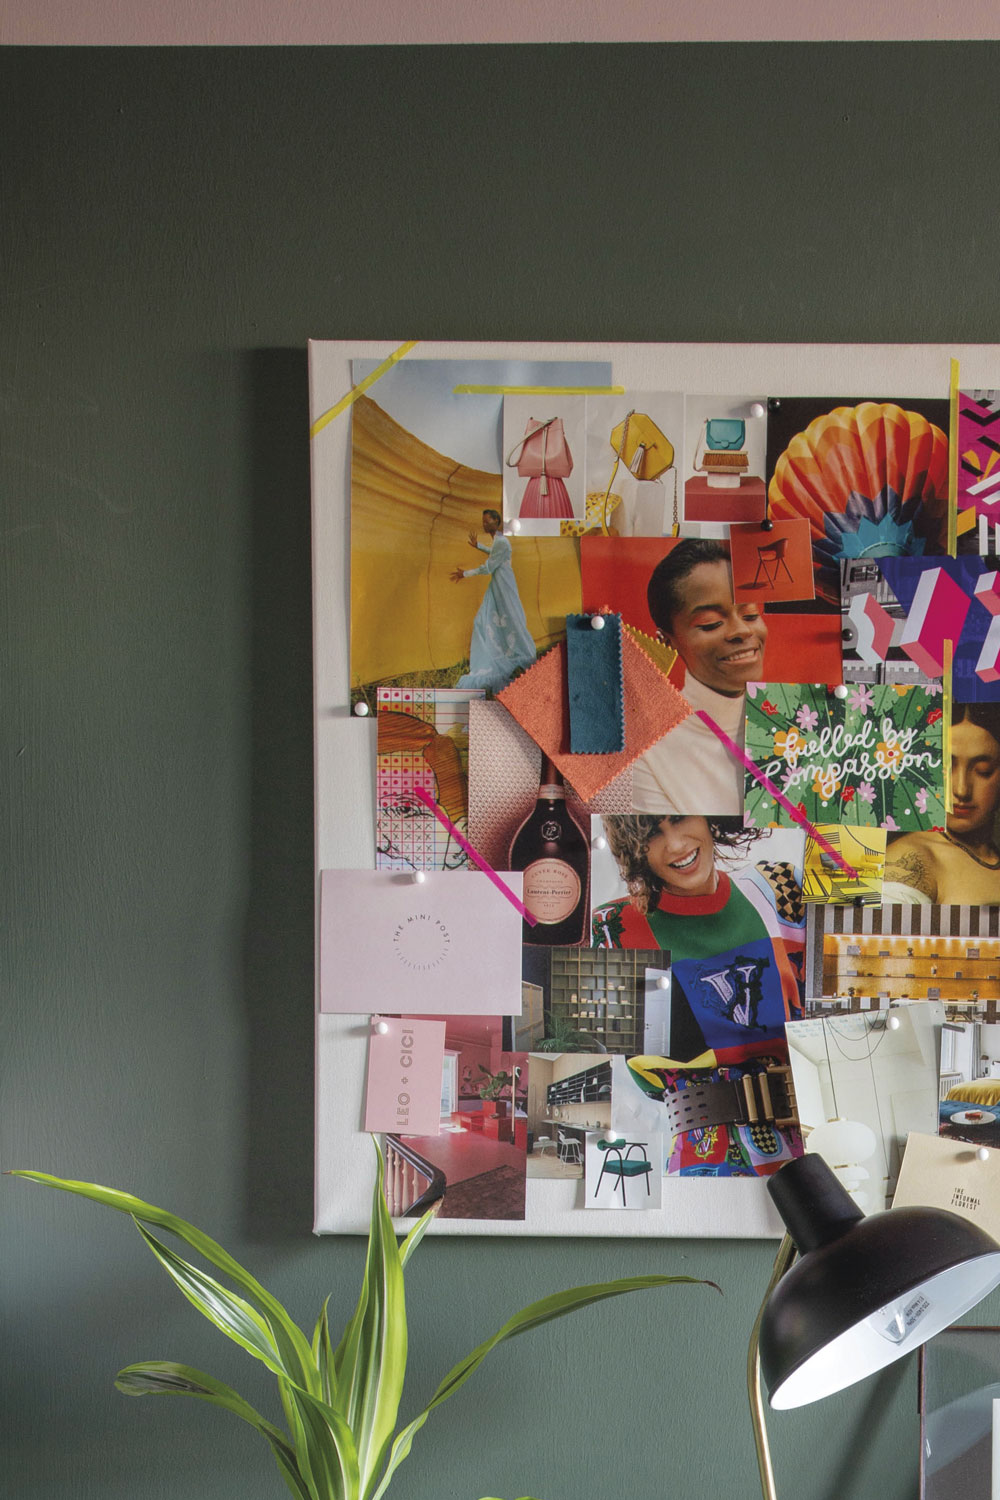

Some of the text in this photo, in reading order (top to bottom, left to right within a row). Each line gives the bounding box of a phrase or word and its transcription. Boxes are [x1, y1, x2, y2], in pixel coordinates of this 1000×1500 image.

[776, 718, 918, 768] fuelled by
[393, 914, 450, 943] THE MINI POST
[400, 1029, 414, 1068] CICI
[396, 1092, 411, 1126] LEO
[951, 1199, 977, 1210] FLORIST
